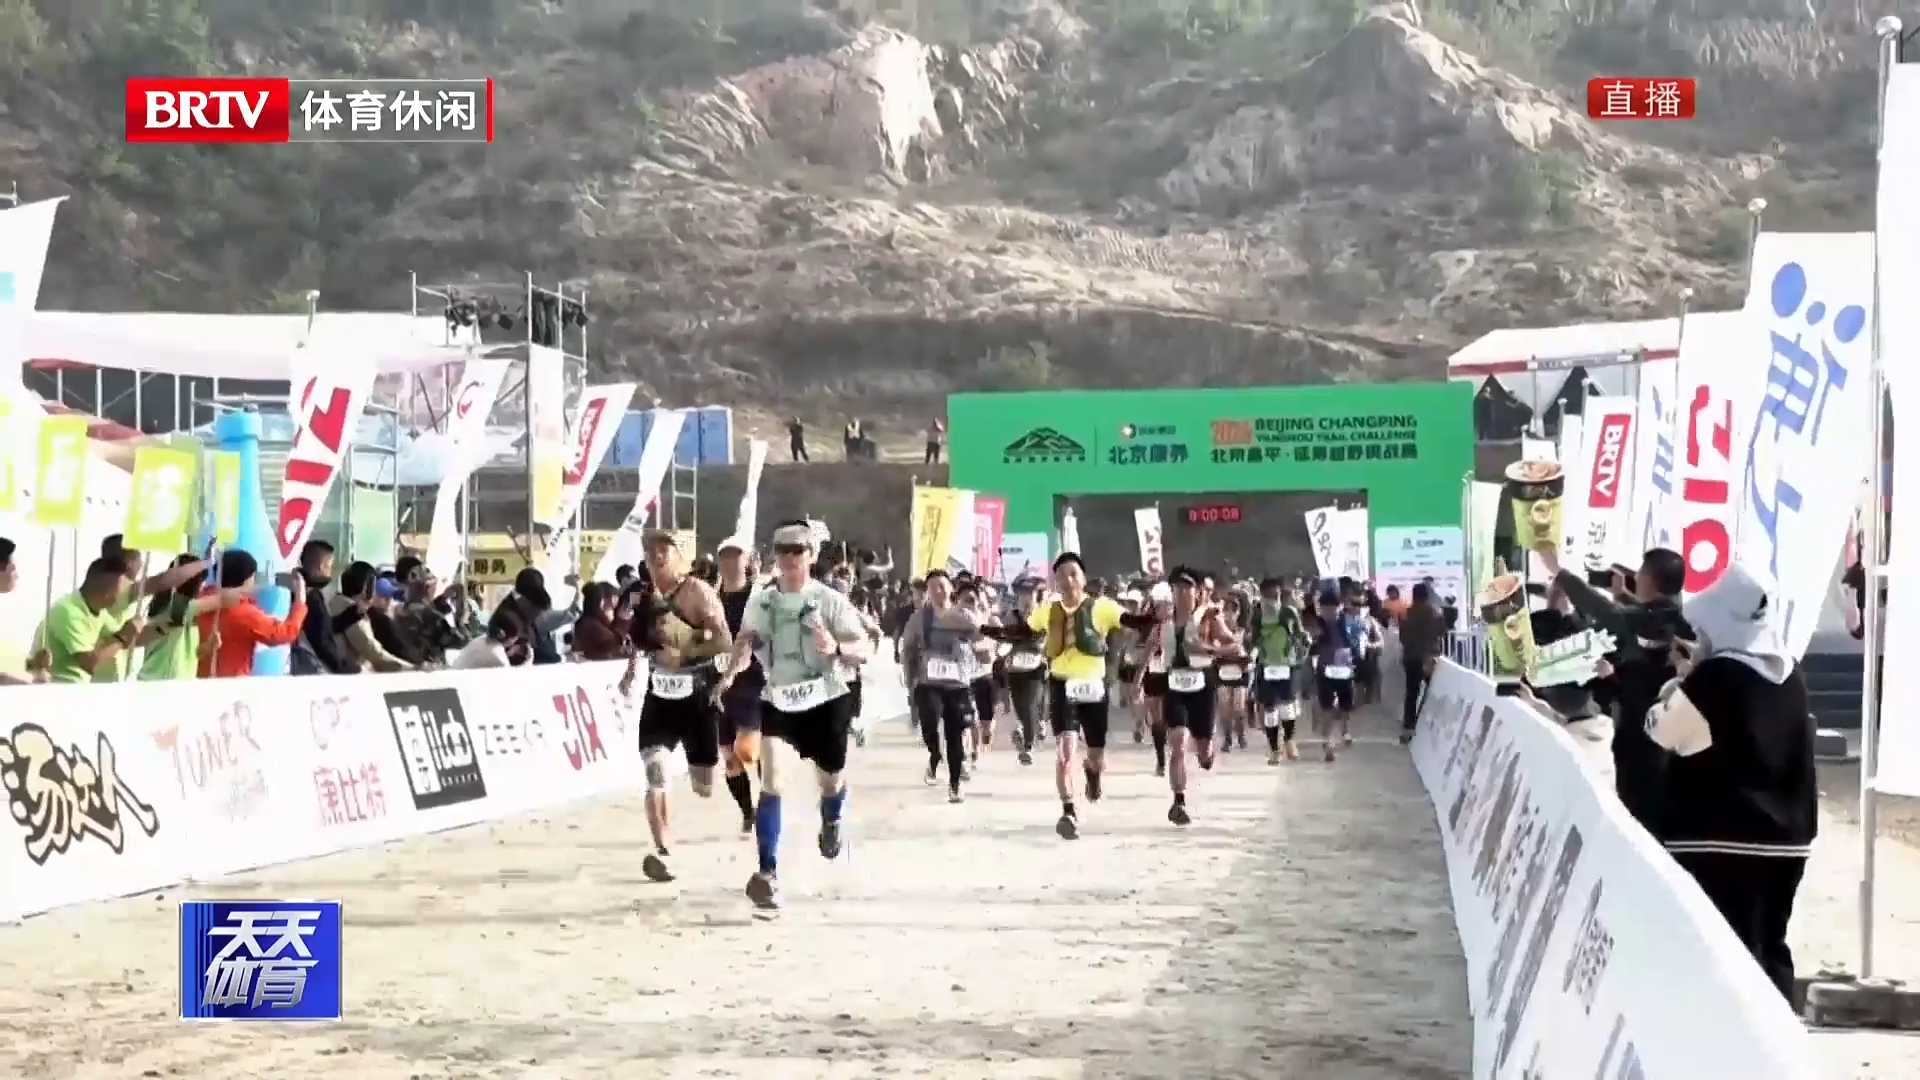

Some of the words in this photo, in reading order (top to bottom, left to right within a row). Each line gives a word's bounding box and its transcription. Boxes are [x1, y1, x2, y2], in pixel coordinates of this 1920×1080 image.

[1255, 417, 1314, 432] BEIJING
[1319, 415, 1417, 429] CHANGPING
[1595, 424, 1625, 497] BRTV
[0, 722, 160, 866] 汤达人
[313, 762, 386, 826] 康比特
